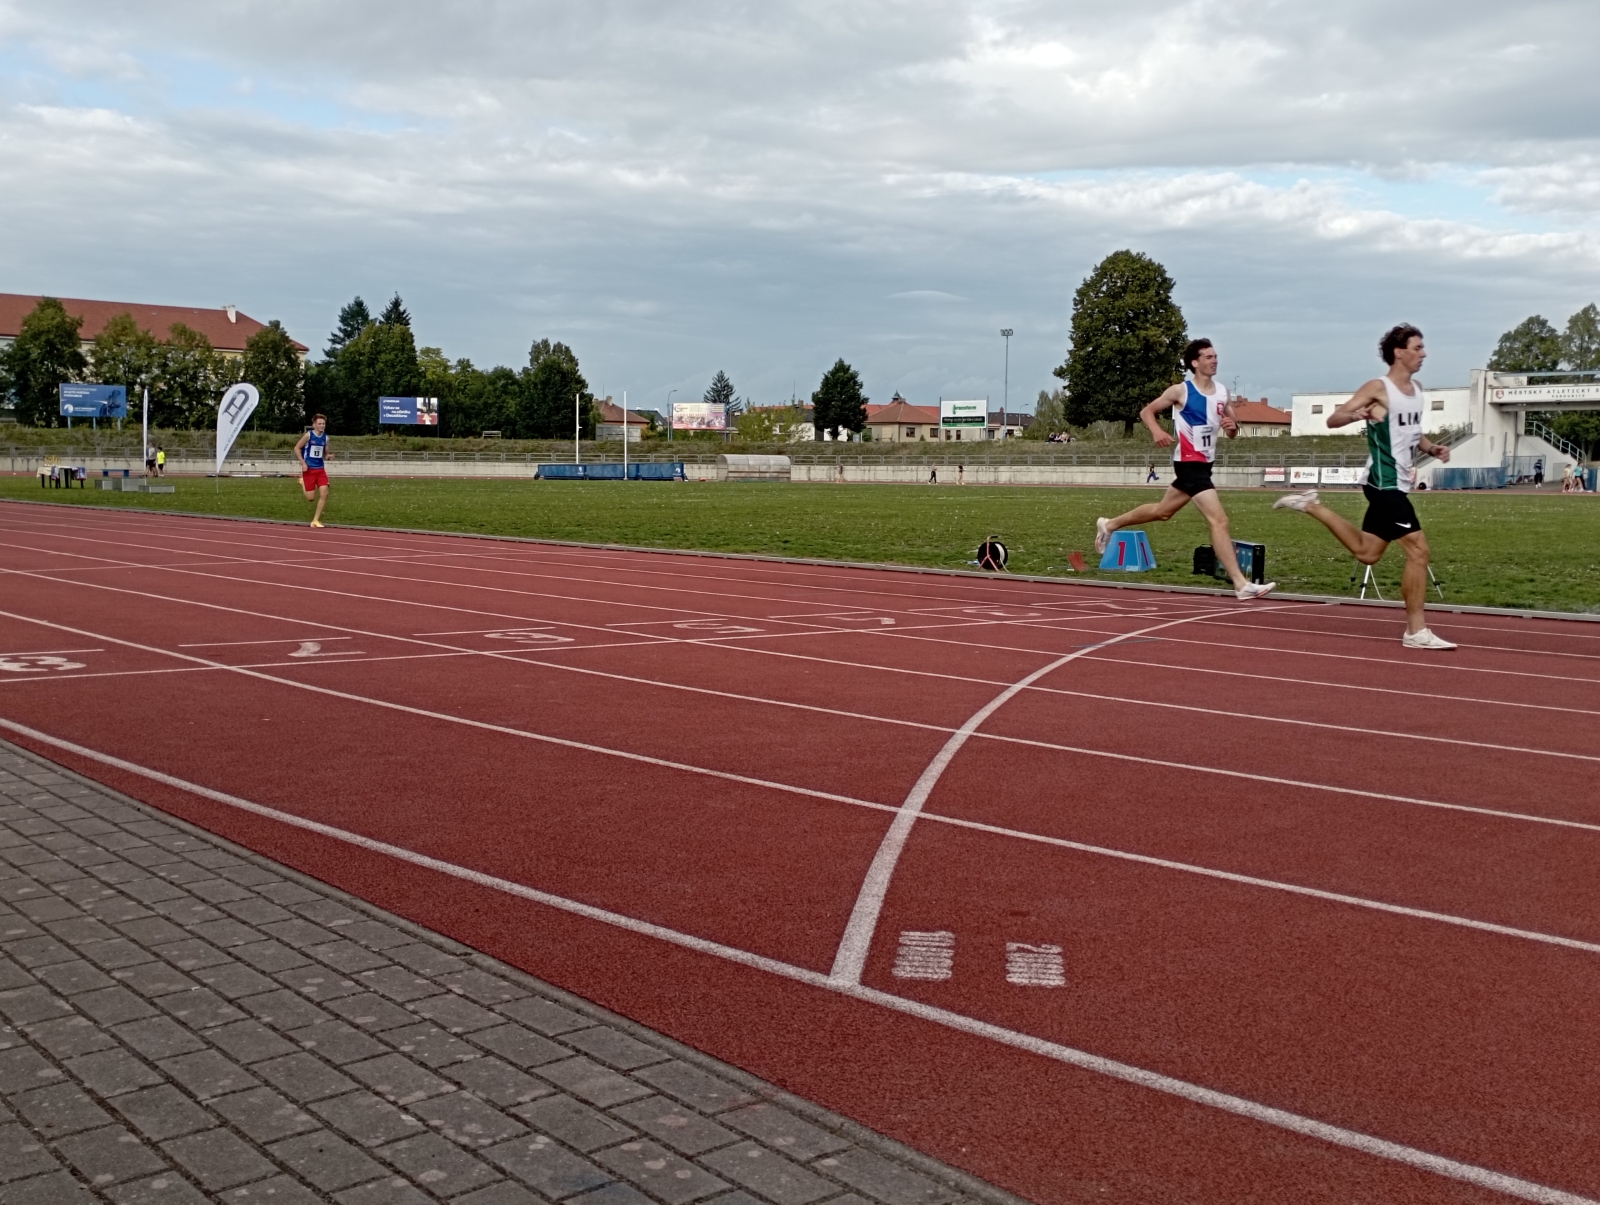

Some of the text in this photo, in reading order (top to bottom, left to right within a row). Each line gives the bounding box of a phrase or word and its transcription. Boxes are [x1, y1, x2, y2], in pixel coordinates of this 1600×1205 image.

[1201, 434, 1211, 447] 11
[1118, 541, 1127, 567] 1
[1140, 541, 1149, 567] 1
